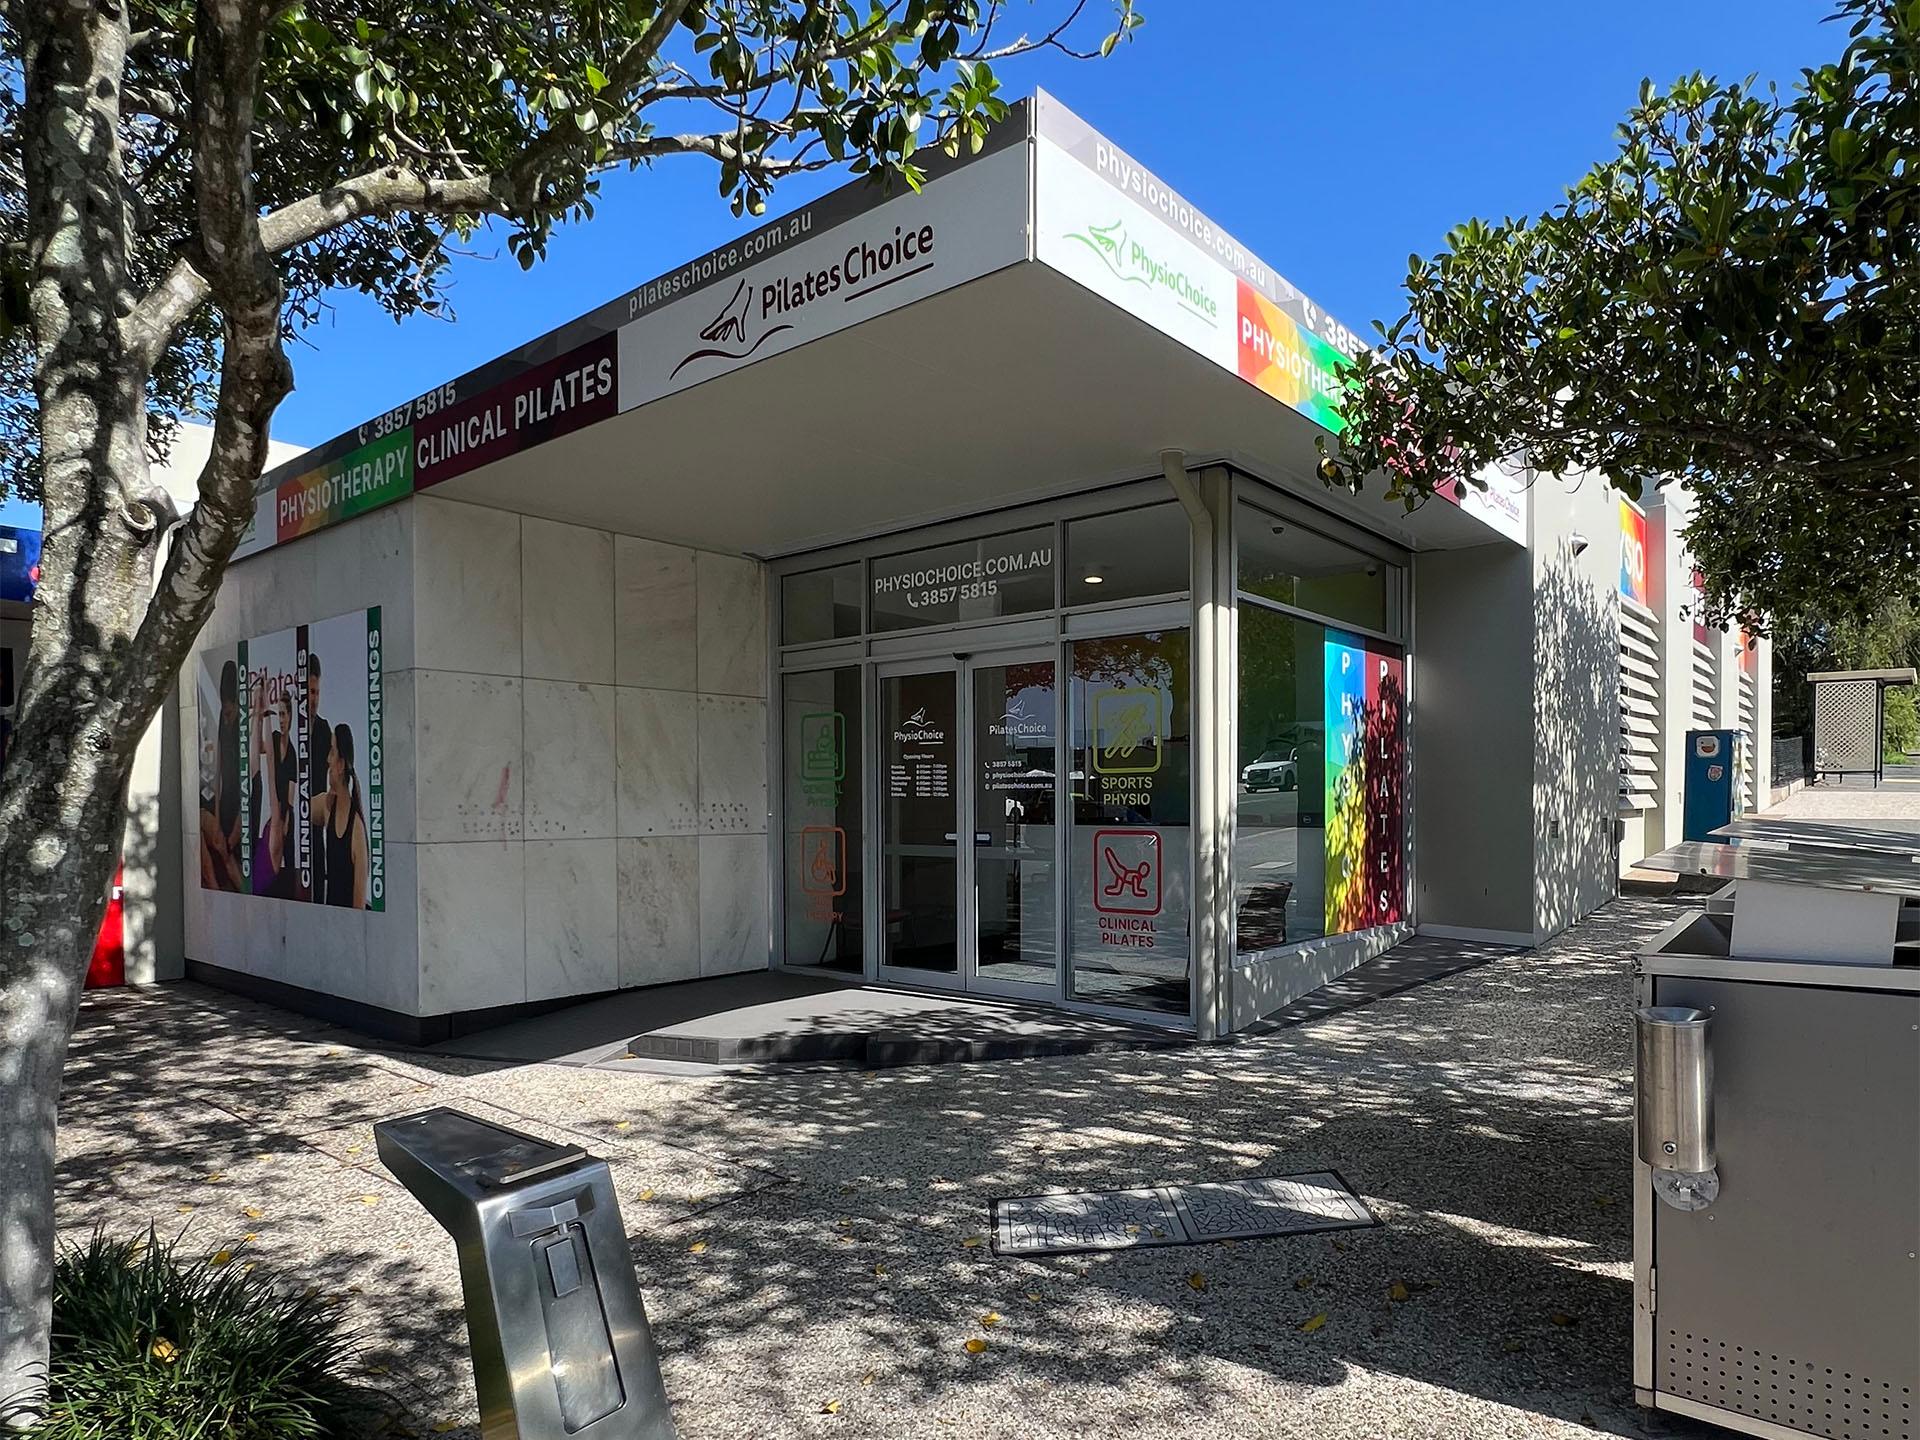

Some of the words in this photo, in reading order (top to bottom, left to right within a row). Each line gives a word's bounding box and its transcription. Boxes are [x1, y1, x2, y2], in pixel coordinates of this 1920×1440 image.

[1096, 141, 1267, 289] physiochoice.com.au
[628, 210, 813, 318] pilateschoice.com.au
[761, 224, 935, 320] PilatesChoice
[1130, 239, 1218, 319] PhysioChoice
[374, 402, 414, 440] 3857
[416, 381, 458, 421] 5815
[416, 409, 507, 470] CLINICAL
[514, 357, 613, 431] PILATES
[279, 445, 408, 528] PHYSIOTHERAPY
[875, 548, 1052, 594] PHYSIOCHOICE.COM.AU
[920, 586, 958, 606] 3857
[960, 579, 998, 600] 5815
[238, 664, 248, 760] PHYSIO
[297, 648, 309, 759] PILATES
[368, 629, 382, 784] BOOKINGS
[894, 729, 944, 743] PhysioChoice
[989, 722, 1047, 736] PilatesChoice
[239, 762, 250, 878] GENERAL
[1101, 776, 1153, 790] SPORTS
[1103, 793, 1150, 806] PHYSIO
[298, 764, 311, 888] CLINICAL
[371, 793, 384, 899] ONLINE
[1098, 917, 1157, 932] CLINICAL
[1102, 932, 1154, 948] PILATES
